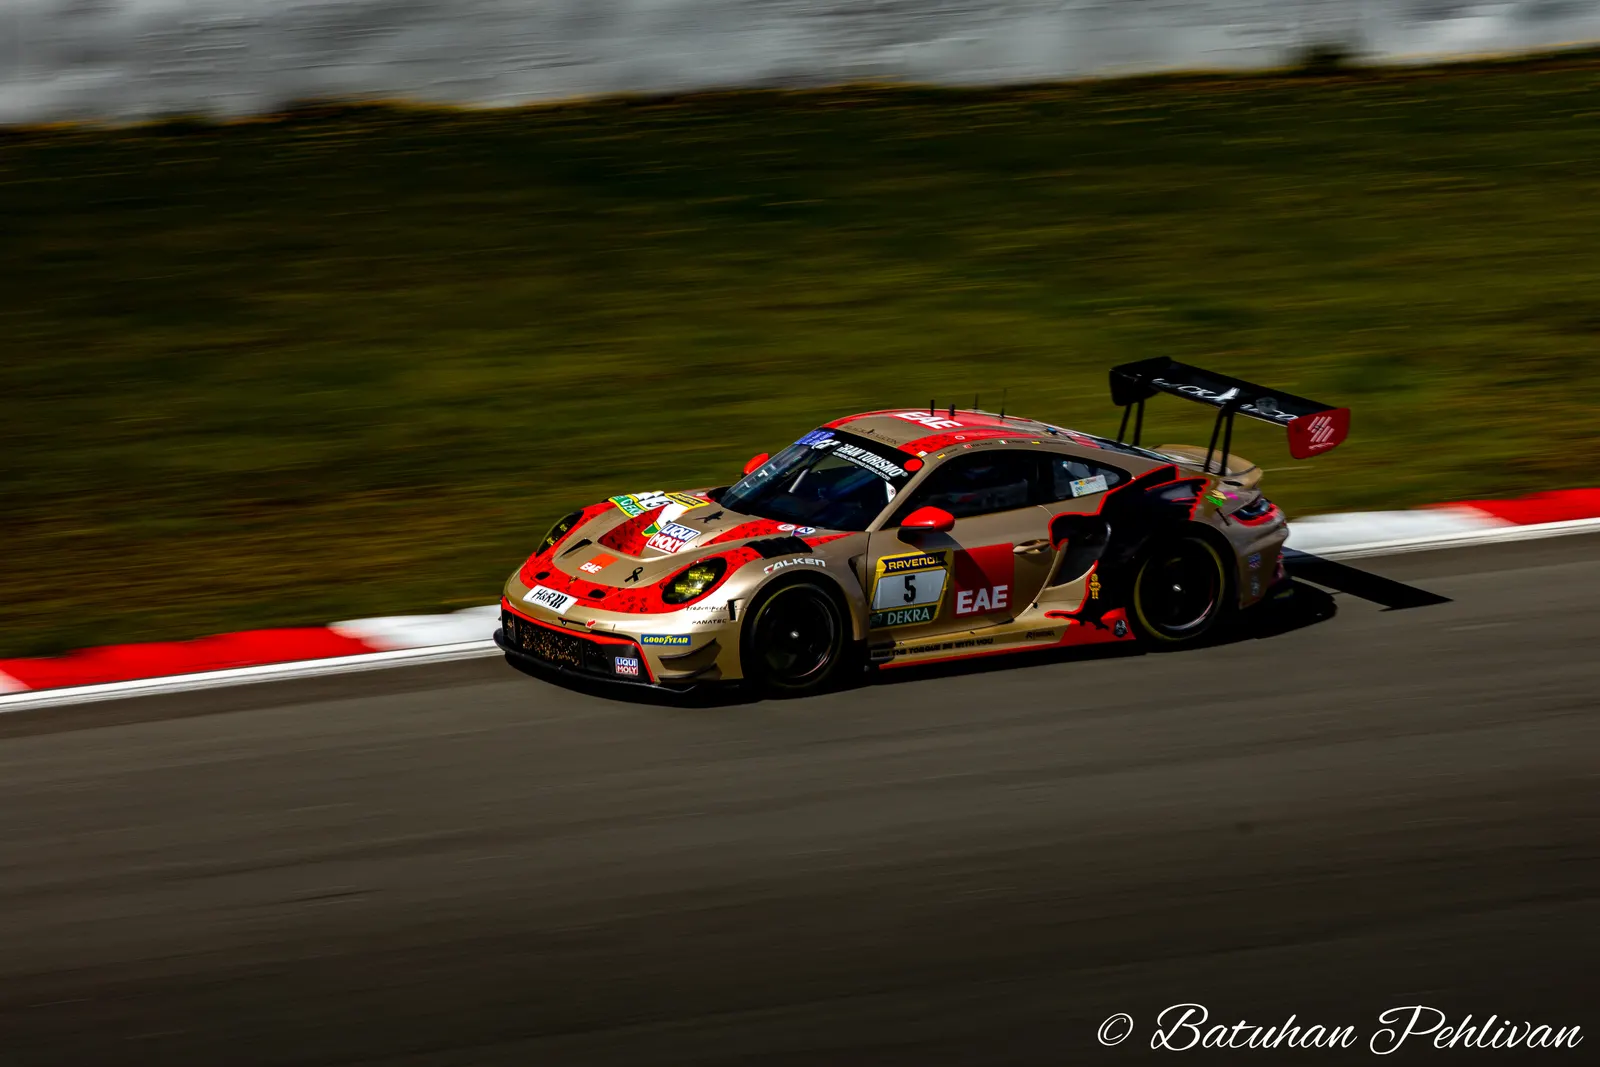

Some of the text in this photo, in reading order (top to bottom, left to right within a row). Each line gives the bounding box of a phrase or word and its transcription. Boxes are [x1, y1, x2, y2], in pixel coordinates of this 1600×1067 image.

[895, 411, 963, 430] EAE
[662, 526, 696, 540] LIQUI
[651, 534, 683, 552] MOLY
[580, 562, 602, 574] EAE
[764, 558, 826, 574] FALKEN
[888, 557, 942, 570] RAVENOL
[903, 575, 916, 602] 5
[956, 585, 1008, 614] EAE
[887, 608, 930, 625] DEKRA
[643, 635, 688, 645] GOODYEAR
[617, 658, 637, 667] LIQUI
[616, 666, 638, 675] MOLY
